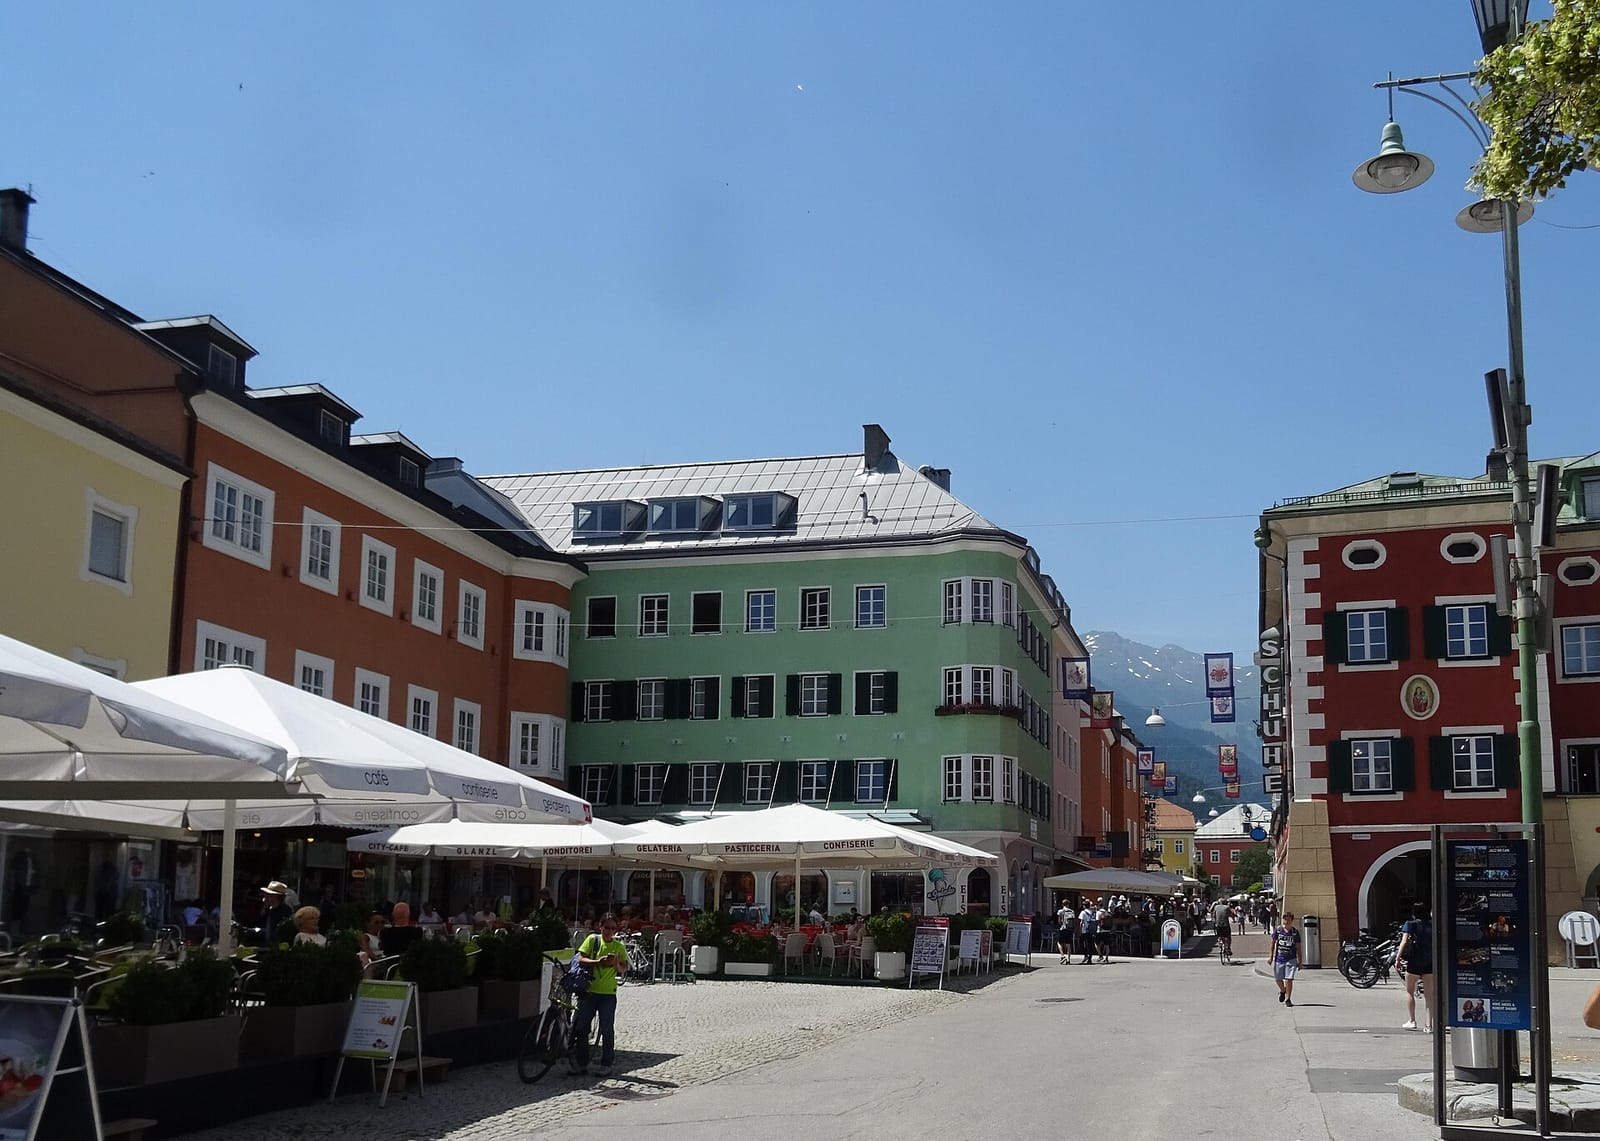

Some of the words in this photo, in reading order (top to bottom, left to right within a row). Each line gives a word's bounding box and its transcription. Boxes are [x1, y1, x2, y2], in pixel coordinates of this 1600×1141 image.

[1261, 640, 1282, 792] SCHUHE
[364, 769, 389, 786] café
[461, 782, 499, 800] confiserie
[542, 798, 571, 815] gelateria
[636, 843, 683, 853] GELATERIA
[724, 844, 781, 853] PASTICCERIA
[823, 839, 875, 850] CONFISERIE
[456, 847, 497, 856] GLANZL
[542, 846, 593, 856] KONDITOREI
